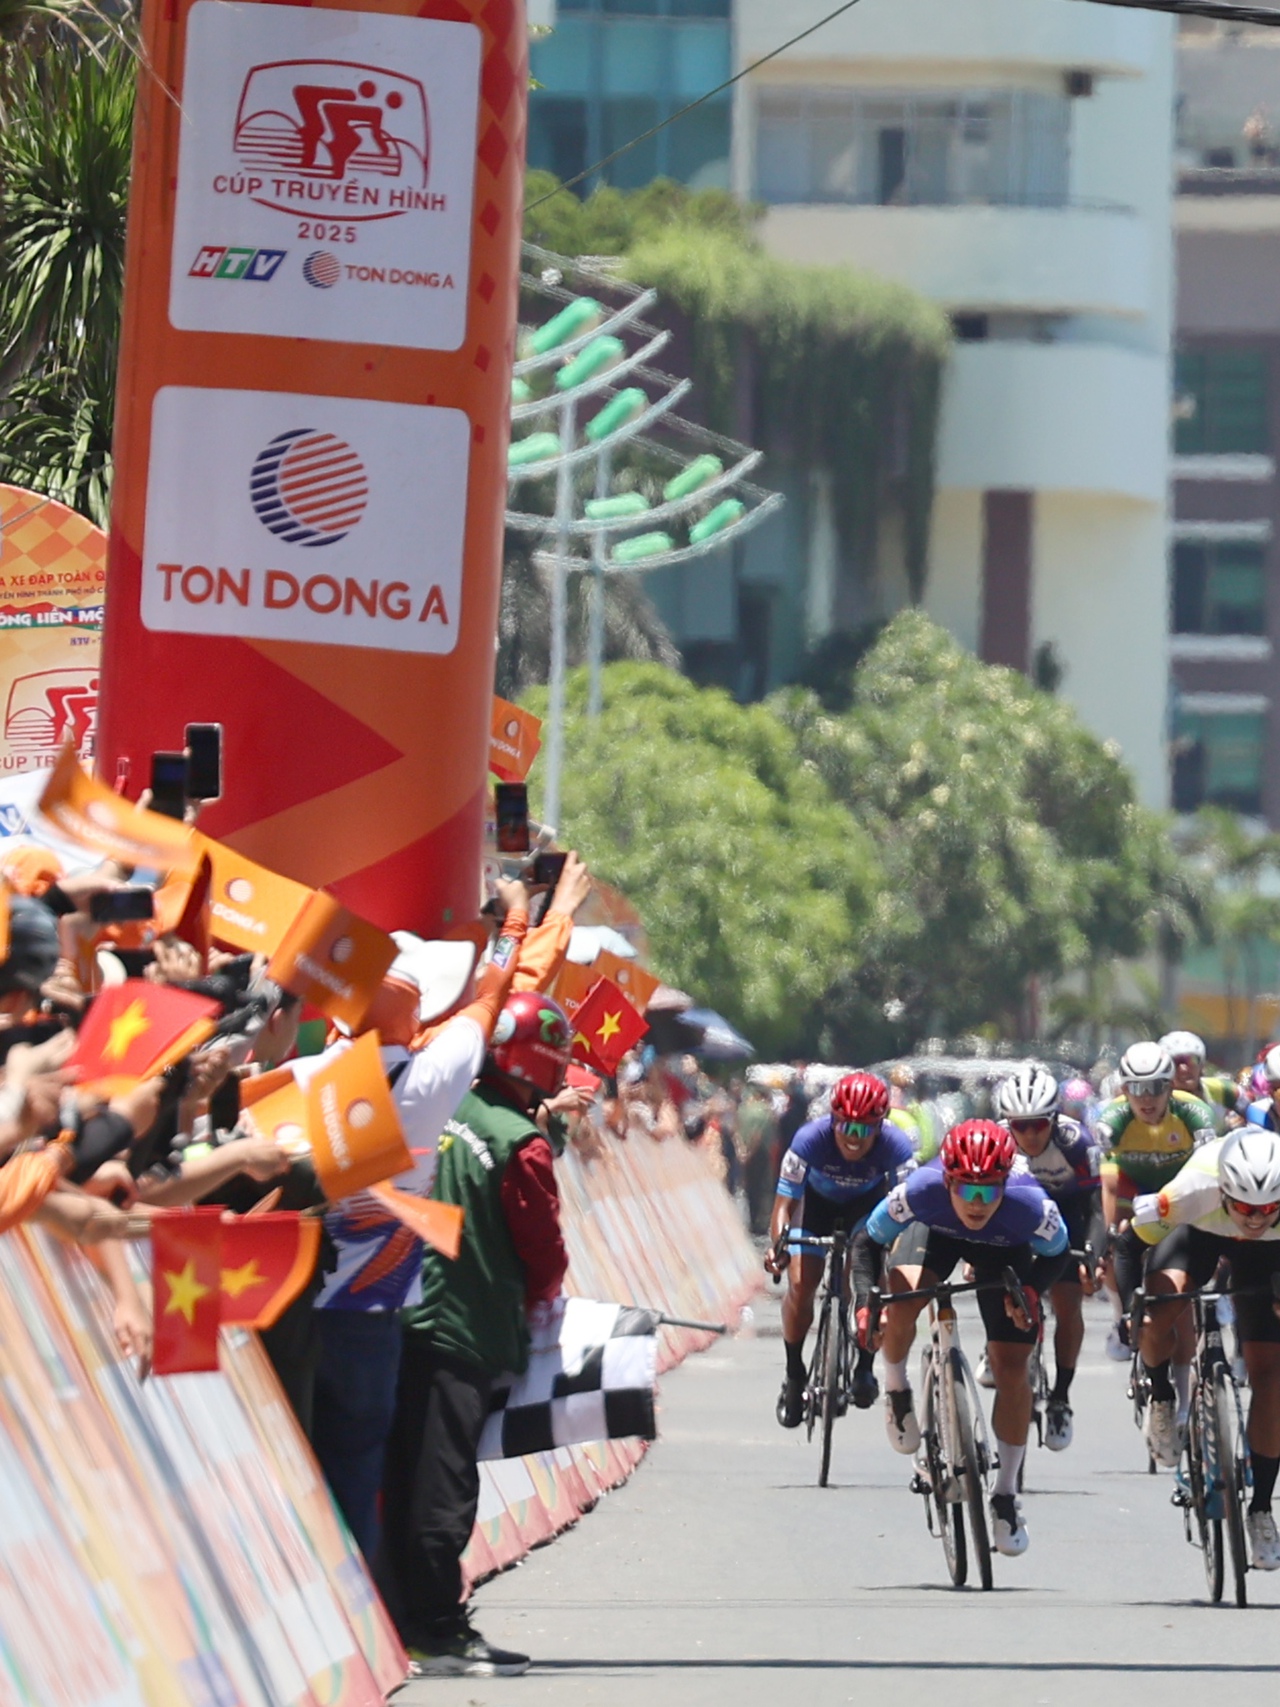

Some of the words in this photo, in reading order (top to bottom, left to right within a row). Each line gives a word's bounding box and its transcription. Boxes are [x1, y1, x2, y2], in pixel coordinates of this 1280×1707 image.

[212, 174, 262, 195] CÚP
[388, 184, 447, 213] HÌNH
[297, 222, 357, 244] 2025
[189, 246, 287, 281] HTV
[345, 264, 387, 283] TON
[390, 269, 441, 288] DONG
[441, 274, 455, 290] A
[11, 575, 25, 586] XE
[156, 562, 251, 608] TON
[263, 570, 410, 621] DONG
[418, 584, 450, 625] A
